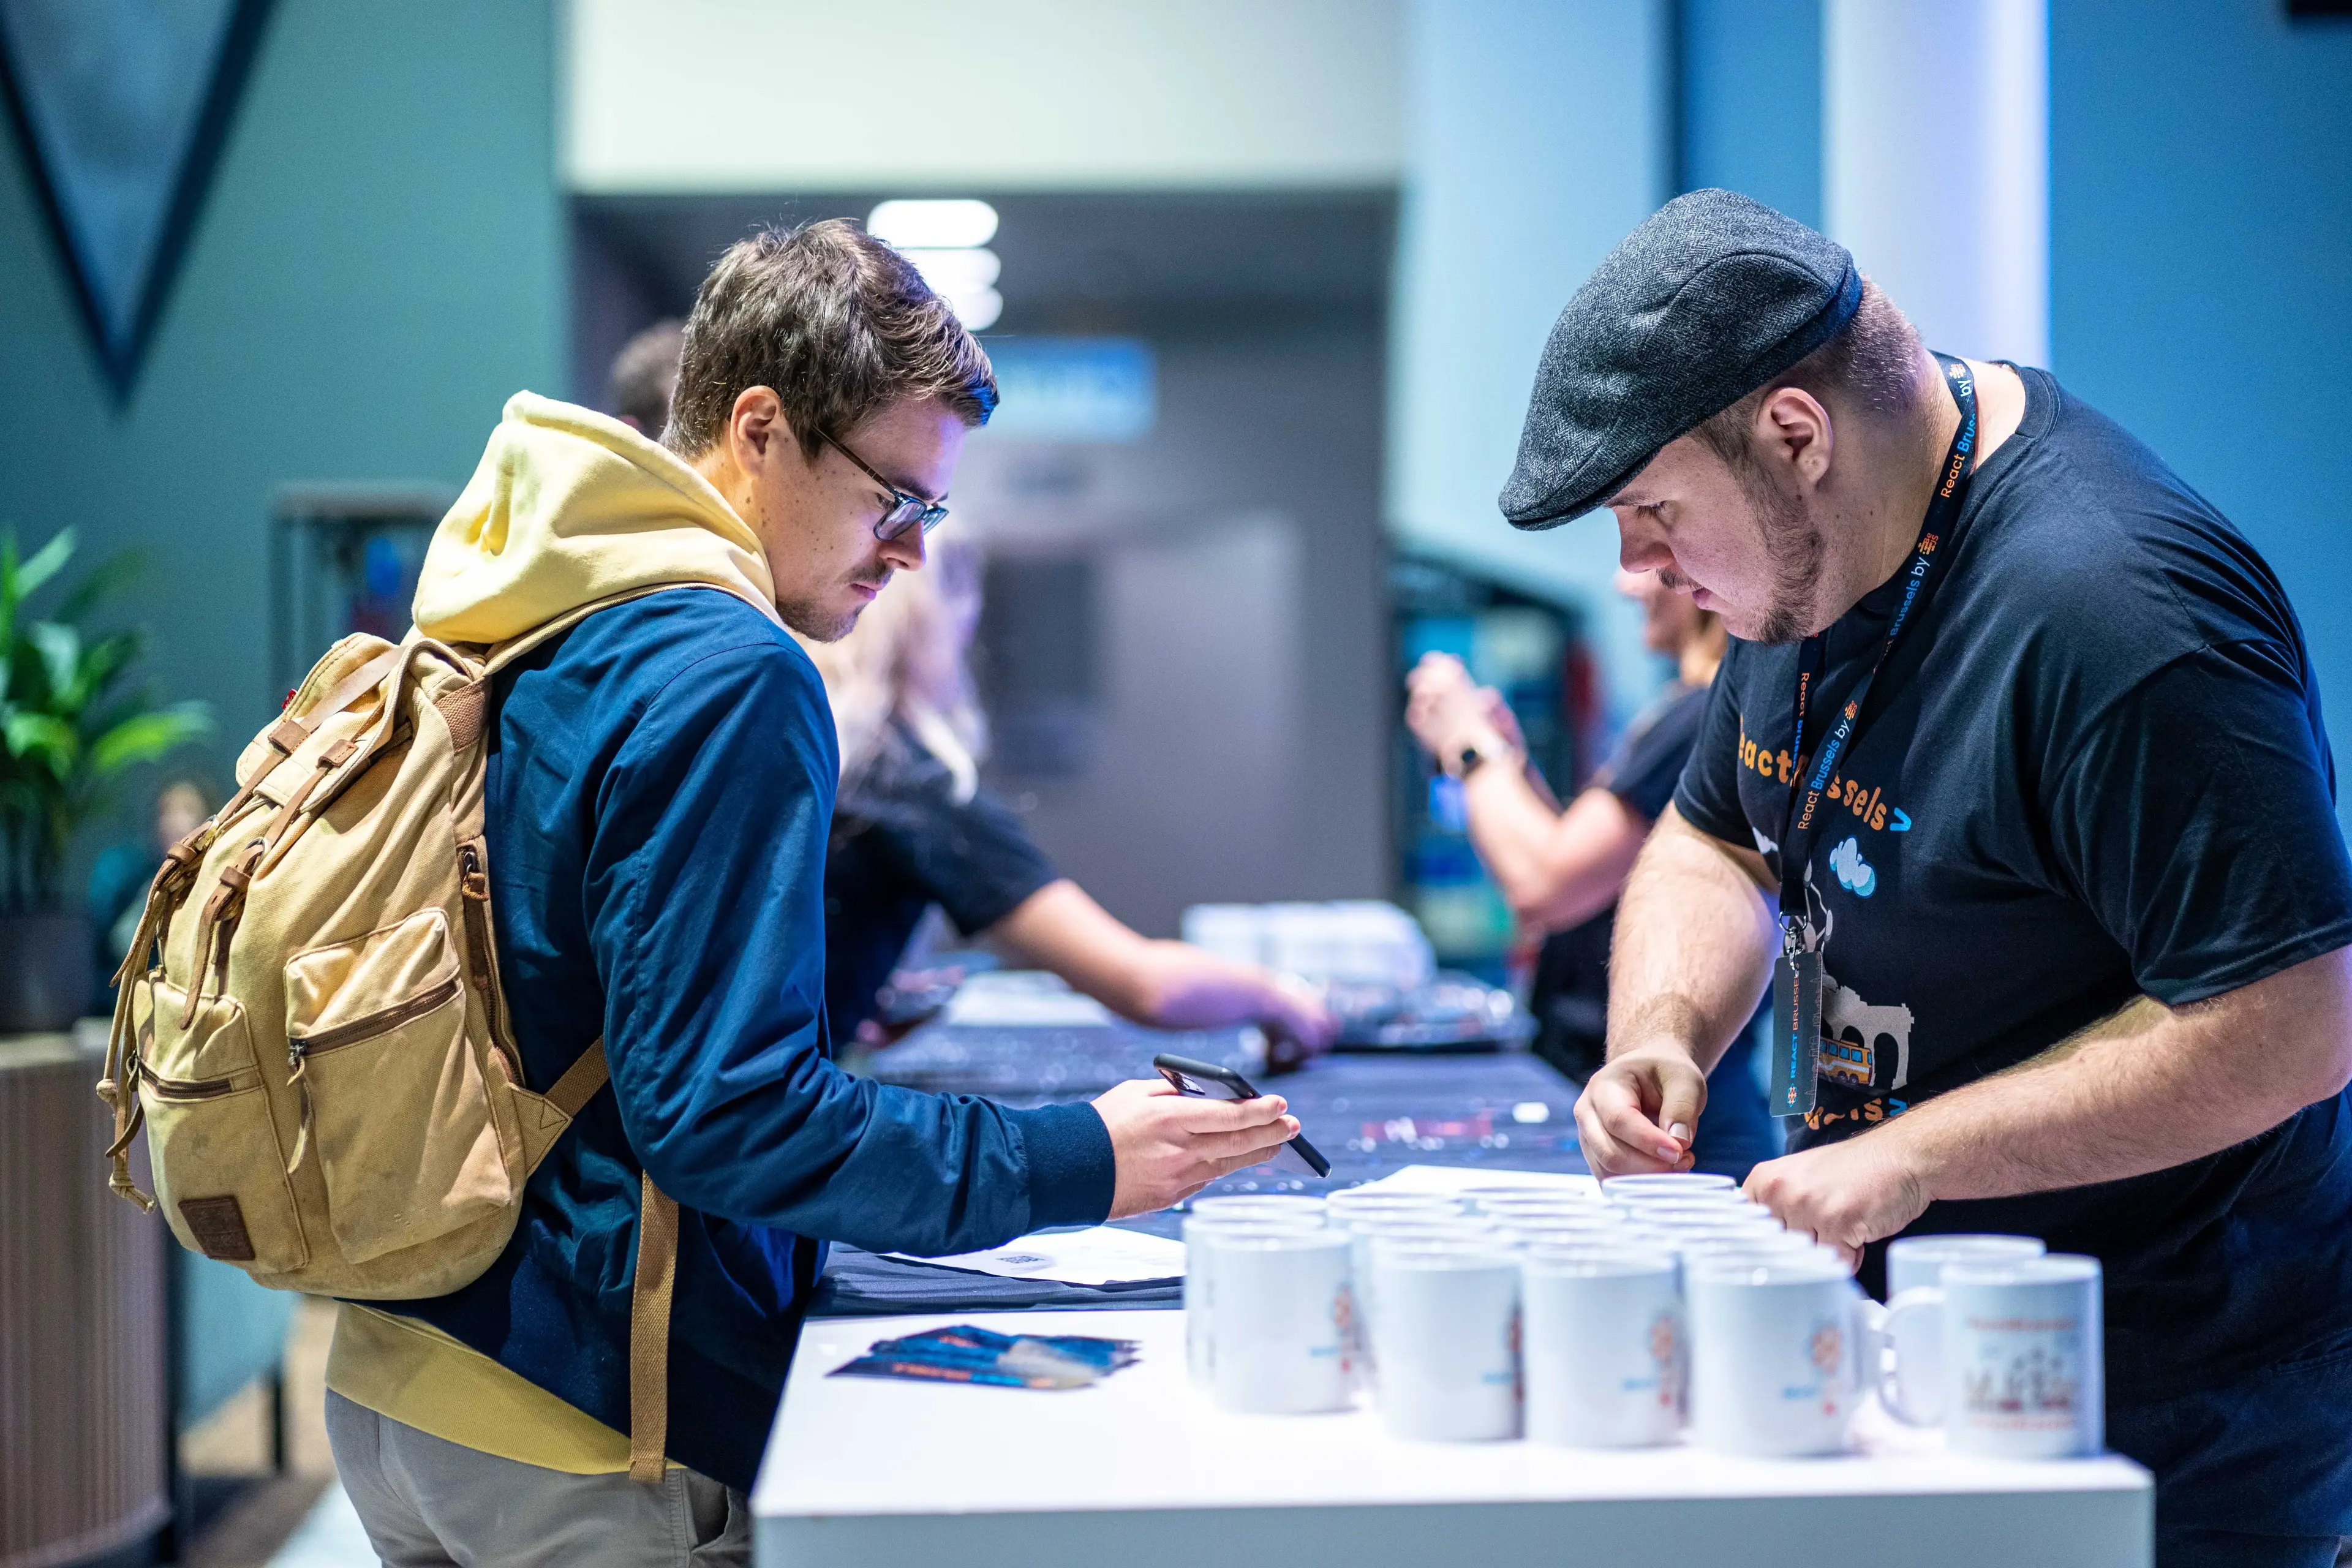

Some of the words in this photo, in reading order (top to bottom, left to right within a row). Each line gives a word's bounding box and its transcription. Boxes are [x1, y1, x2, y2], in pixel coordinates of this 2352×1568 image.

[1958, 380, 1972, 397] by
[1940, 454, 1966, 497] React
[1890, 579, 1920, 636] Brussels
[1911, 556, 1931, 576] by
[1798, 791, 1820, 829] React
[1811, 739, 1840, 790] Brussels
[1834, 720, 1850, 739] by
